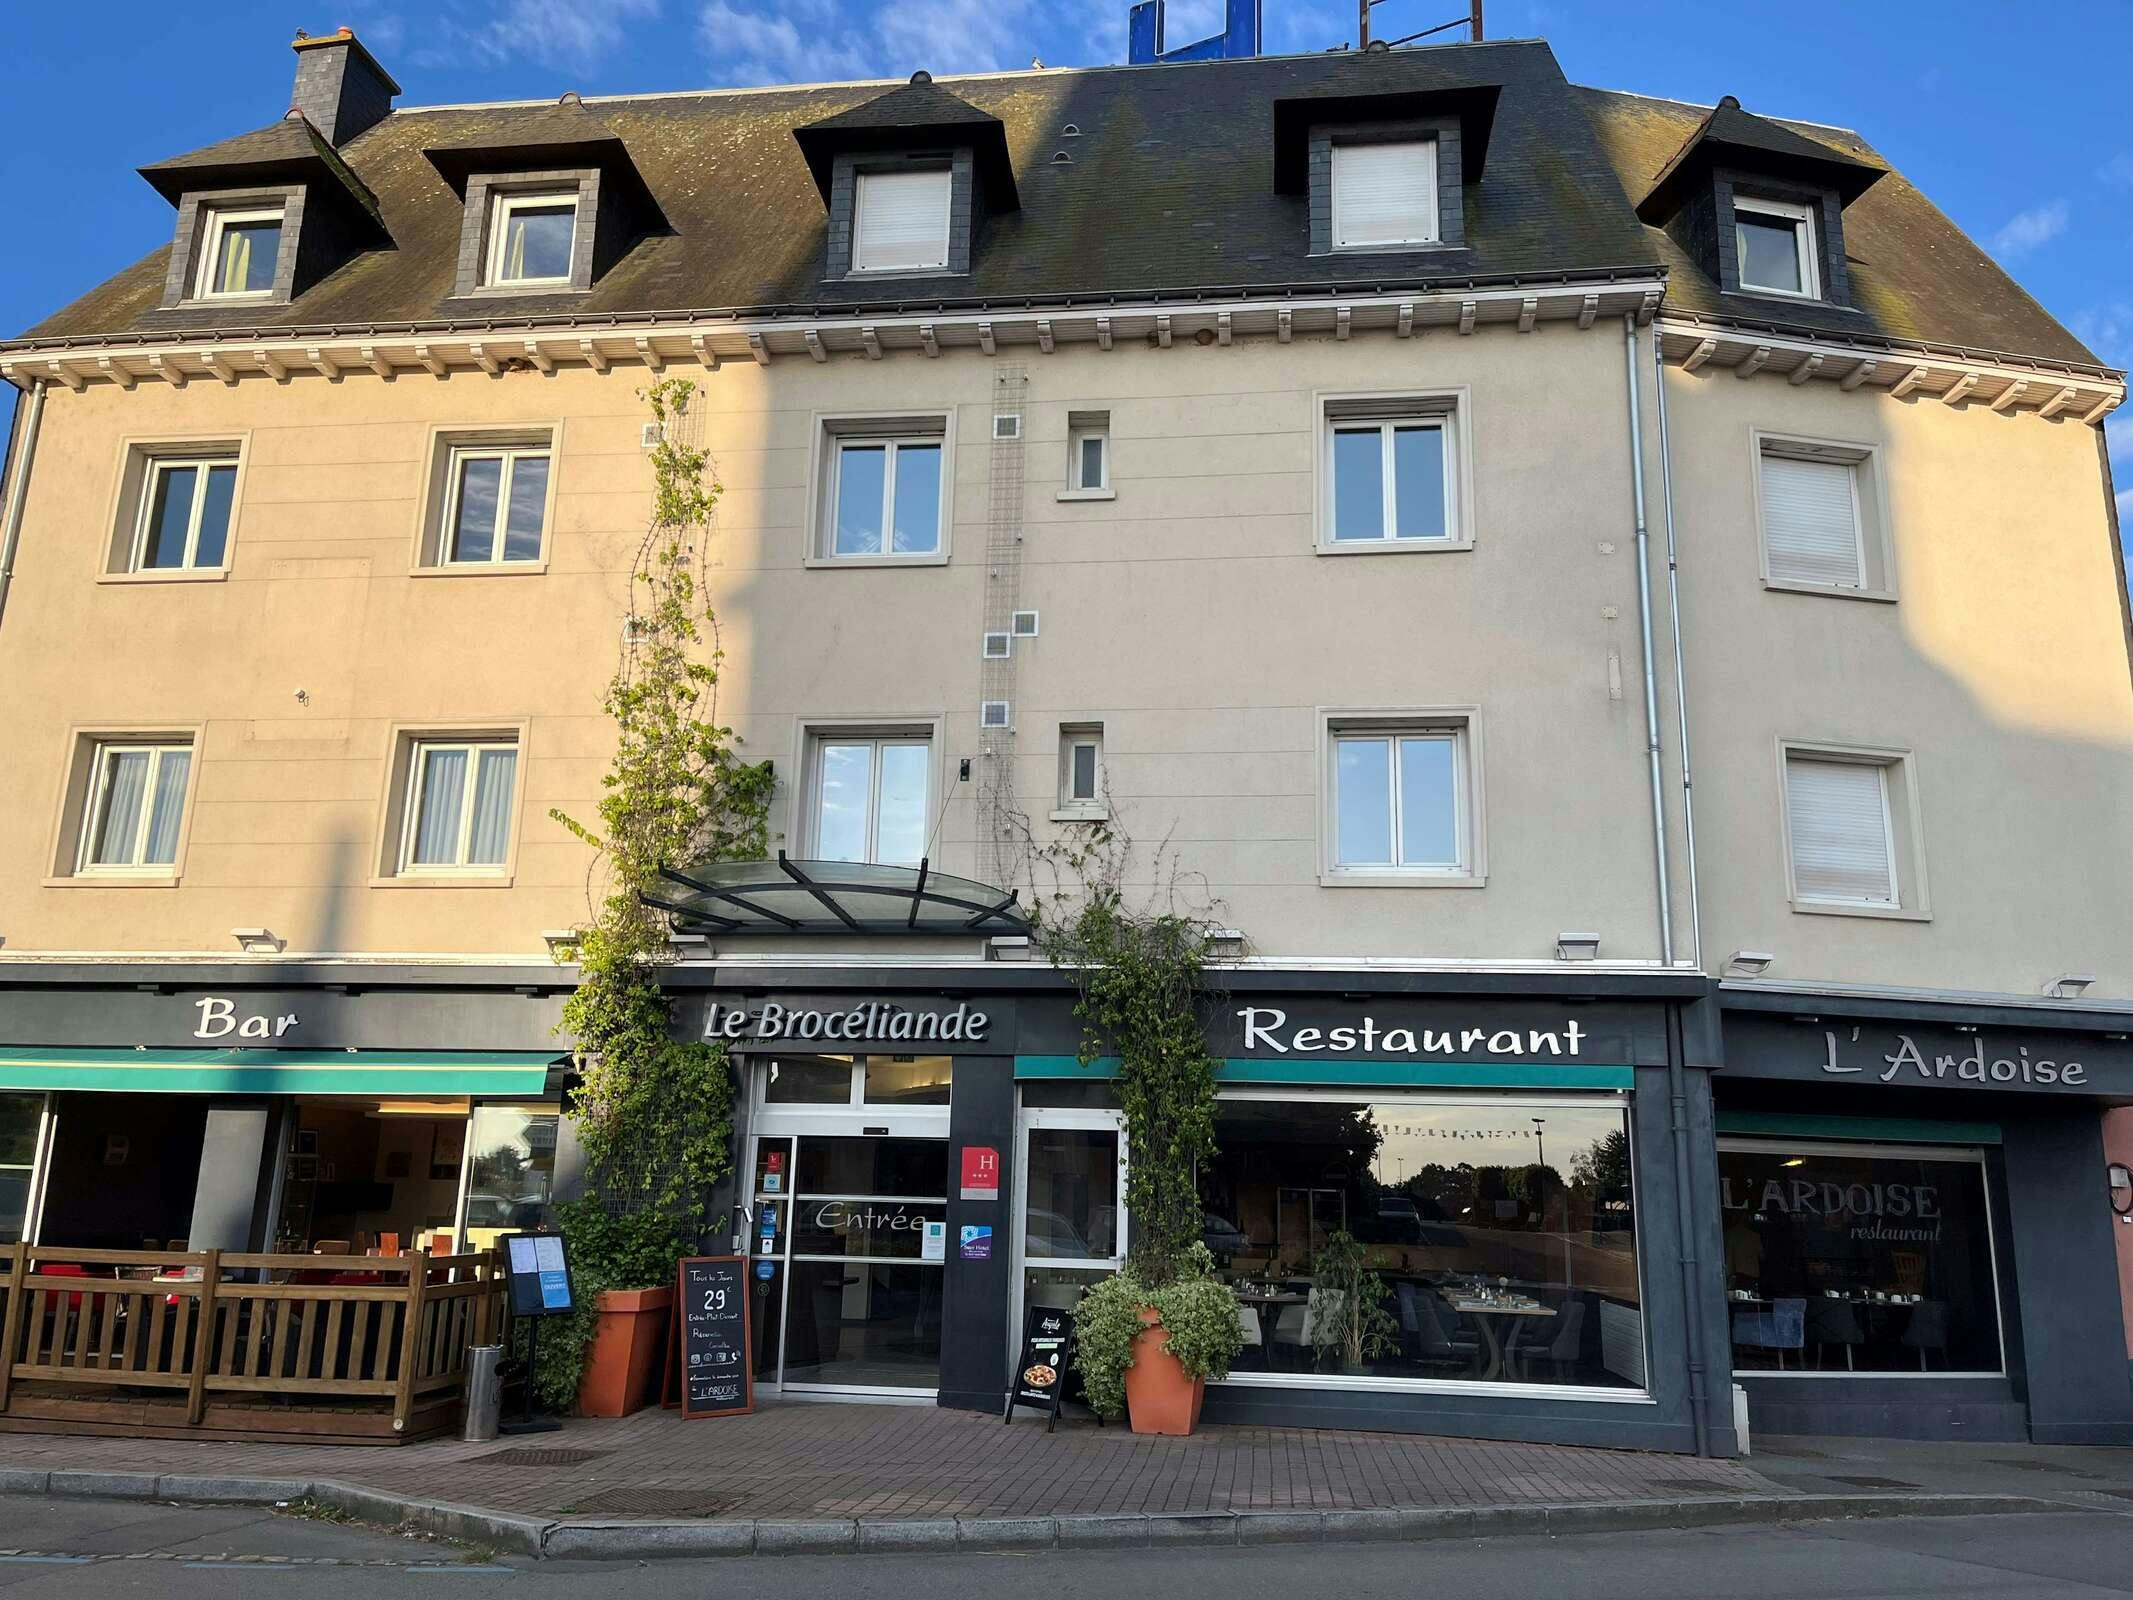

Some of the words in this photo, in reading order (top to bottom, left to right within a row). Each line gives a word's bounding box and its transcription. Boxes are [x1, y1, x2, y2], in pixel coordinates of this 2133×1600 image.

[193, 996, 298, 1039] Bar
[703, 1001, 747, 1039] Le
[756, 1001, 988, 1040] Brocéliande
[1236, 1006, 1588, 1056] Restaurant
[979, 1154, 995, 1170] H
[815, 1201, 926, 1231] Entrée
[1849, 1219, 1942, 1242] restaurant
